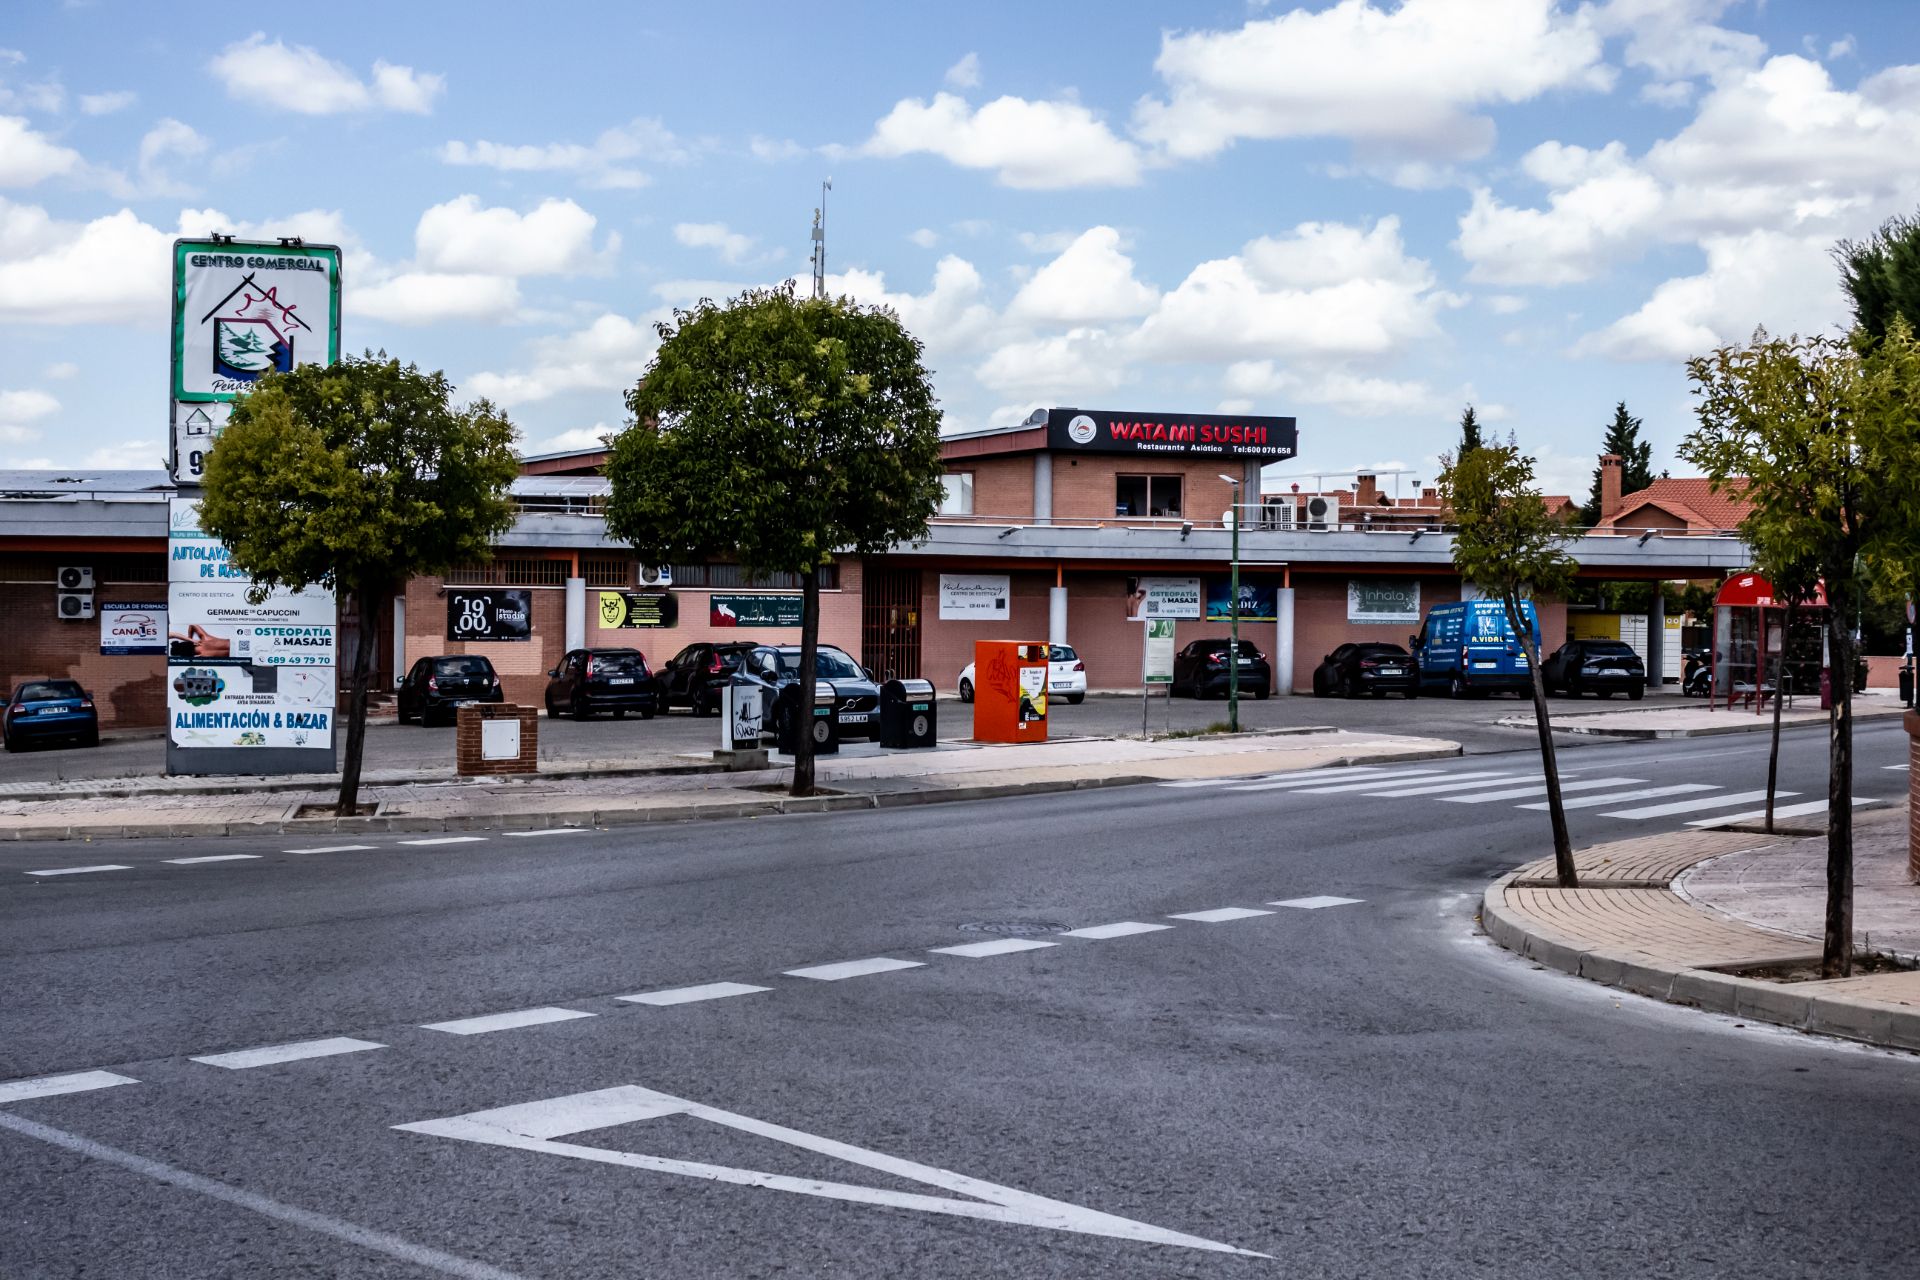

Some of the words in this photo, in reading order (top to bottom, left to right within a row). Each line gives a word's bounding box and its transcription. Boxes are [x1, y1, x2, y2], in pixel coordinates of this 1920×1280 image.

[191, 254, 244, 268] CENTRO
[247, 256, 324, 272] COMERCIAL
[212, 379, 256, 393] Peñas
[1109, 421, 1196, 442] WATAMI
[1200, 424, 1267, 444] SUSHI
[1137, 442, 1185, 451] Restaurante
[1190, 443, 1223, 452] Asiático
[189, 450, 204, 476] 9
[172, 546, 231, 561] AUTOLAVA
[200, 563, 214, 578] DE
[218, 564, 249, 579] MAS
[1226, 600, 1258, 608] CDIZ
[499, 610, 525, 620] studio
[112, 626, 157, 637] CANALES
[254, 626, 332, 637] OSTEOPATÍA
[274, 638, 281, 646] &
[284, 638, 332, 646] MASAJE
[175, 709, 269, 728] ALIMENTACIÓN
[274, 712, 282, 728] &
[286, 712, 328, 729] BAZAR
